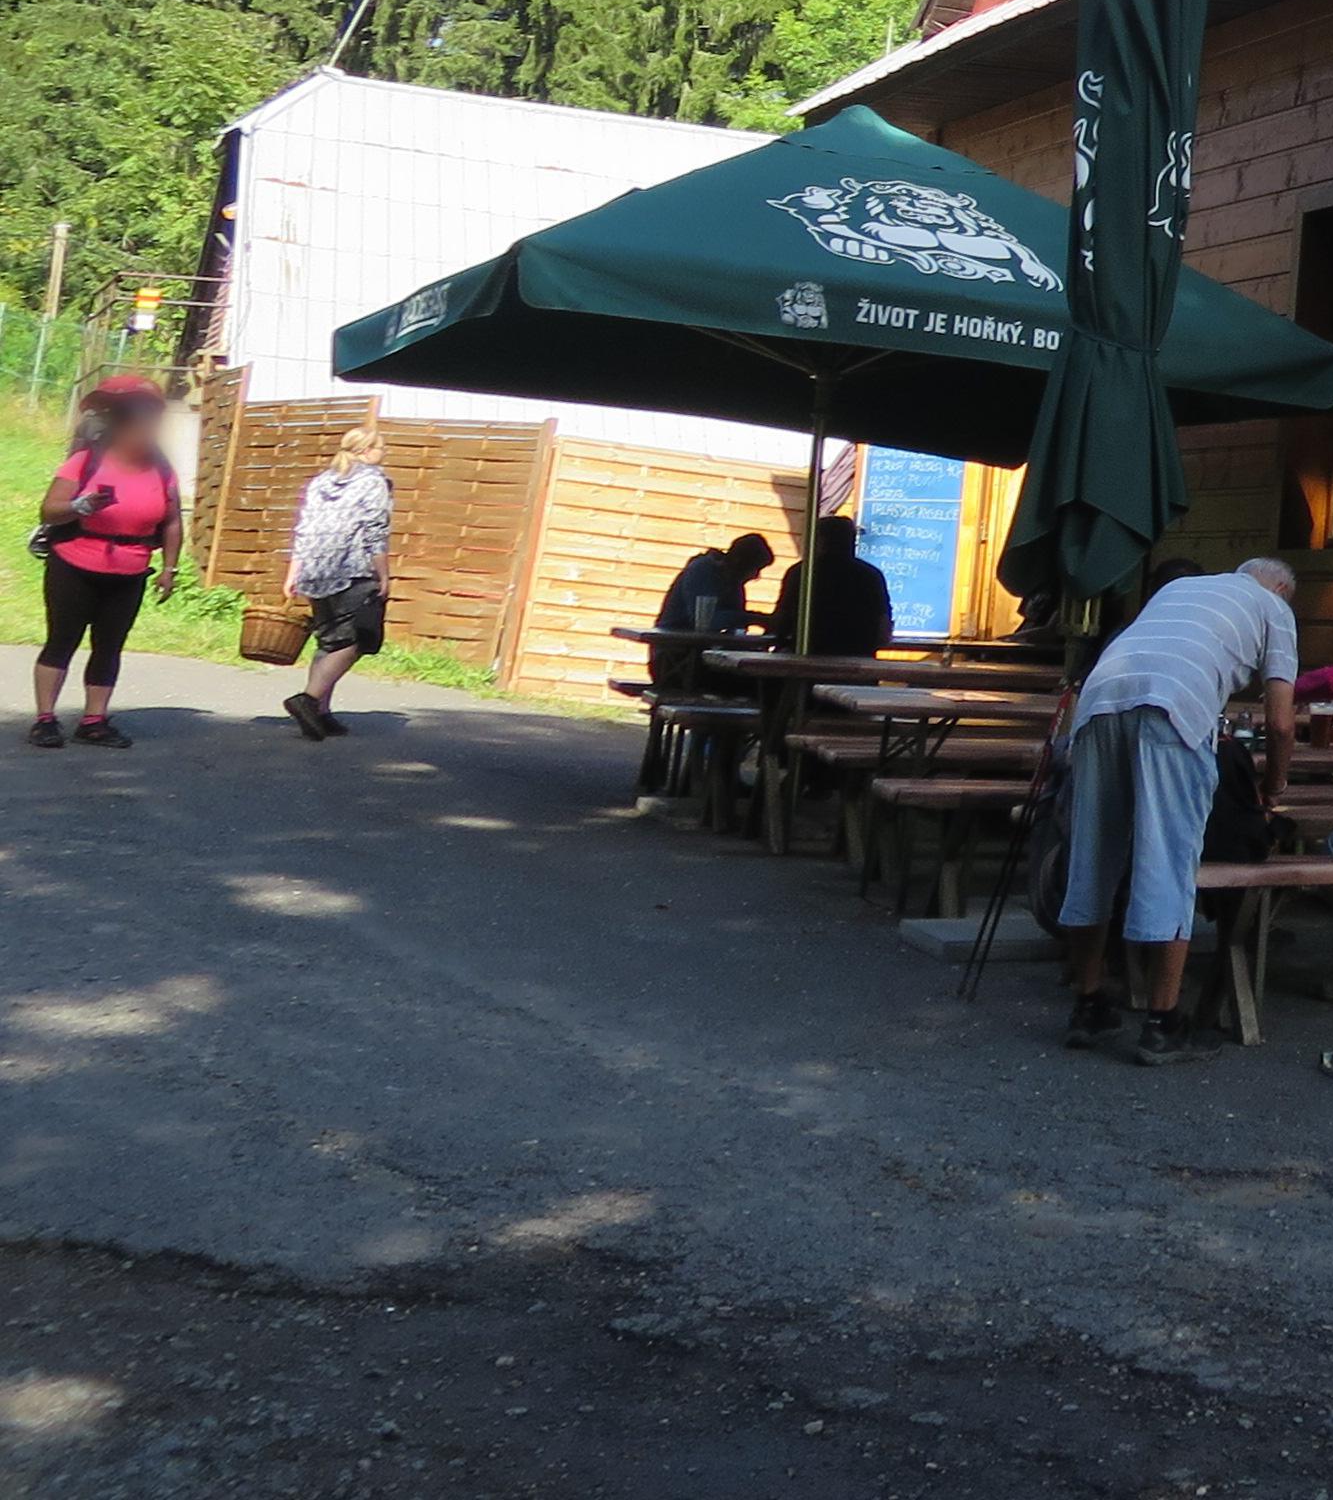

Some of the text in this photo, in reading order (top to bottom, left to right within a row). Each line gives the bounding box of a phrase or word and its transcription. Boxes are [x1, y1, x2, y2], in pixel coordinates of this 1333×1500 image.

[856, 298, 919, 329] ŽIVOT
[923, 312, 947, 334] JE
[953, 315, 1026, 345] HOŘKÝ.
